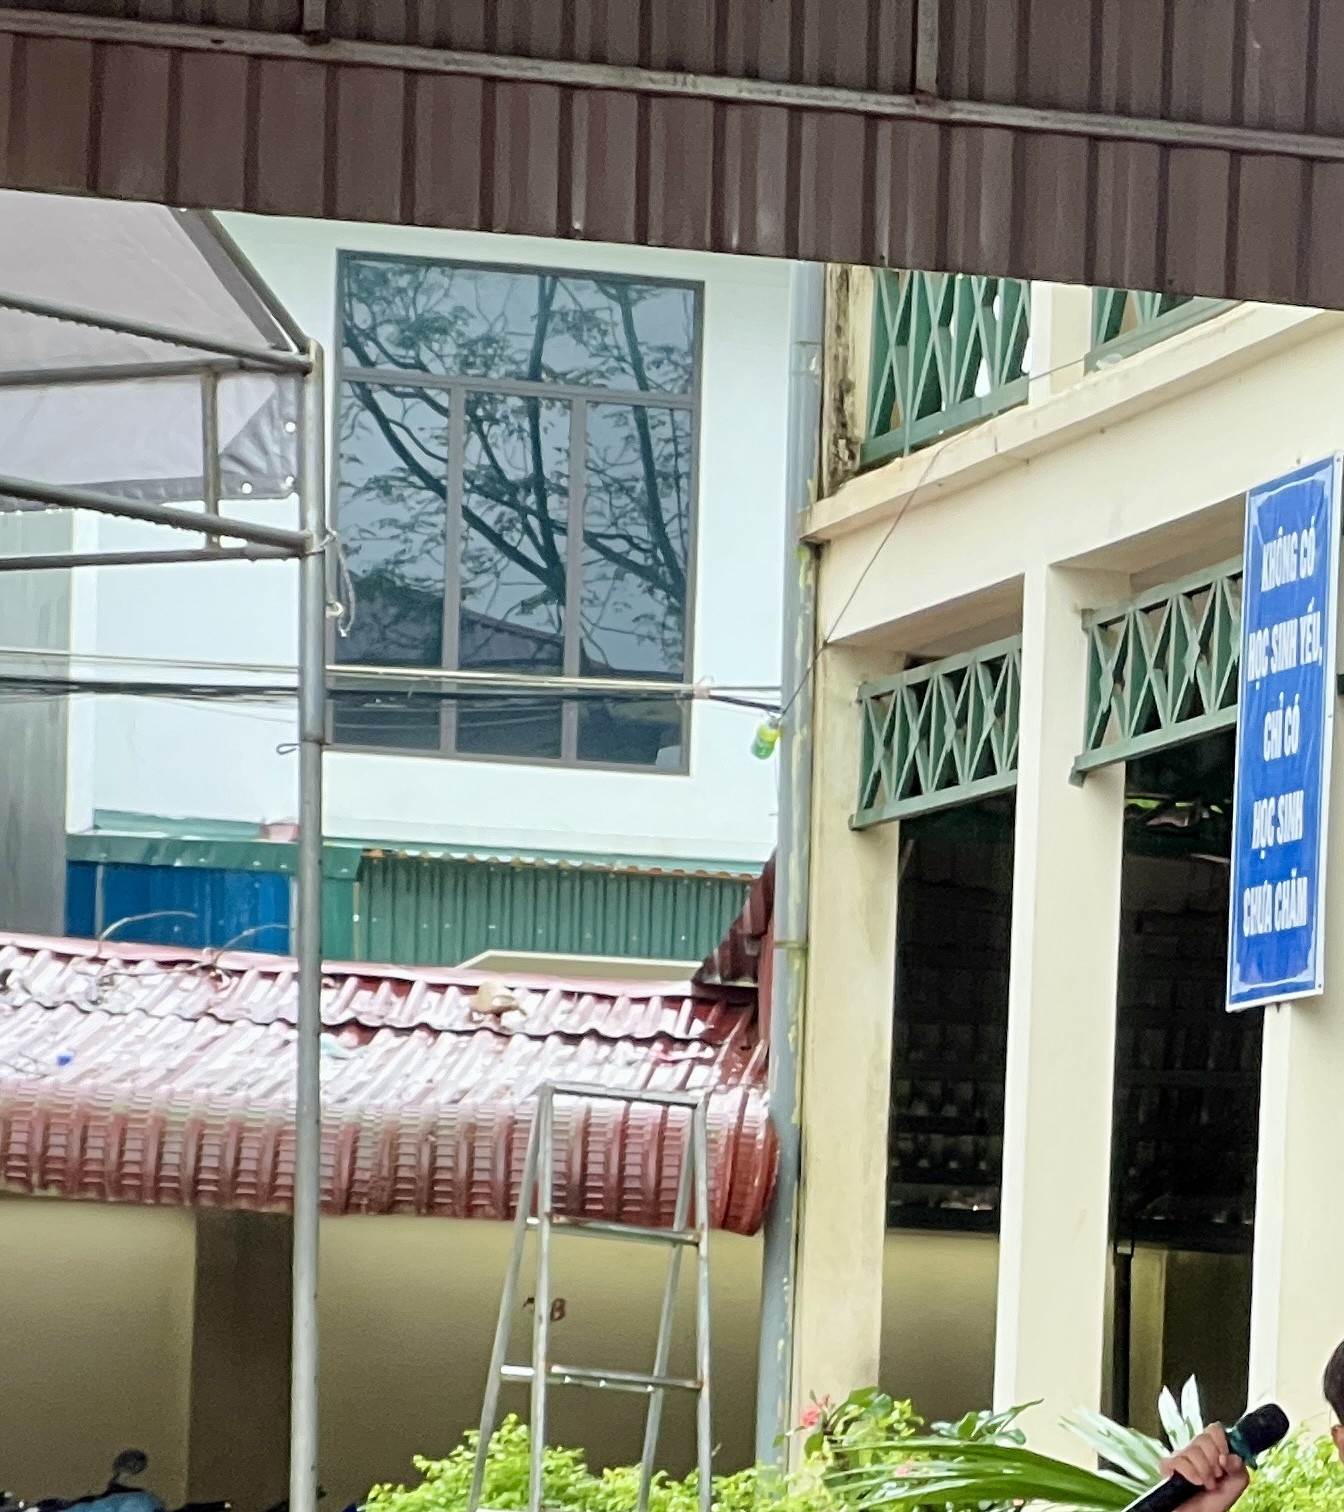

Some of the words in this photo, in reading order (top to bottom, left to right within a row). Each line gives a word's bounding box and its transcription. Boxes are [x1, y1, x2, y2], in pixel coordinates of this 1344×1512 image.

[1260, 526, 1299, 592] KHÔNG
[1299, 515, 1317, 579] CÓ
[1248, 627, 1270, 690] HỌC
[1270, 618, 1299, 674] SINH
[1263, 691, 1284, 761] CHỈ
[1284, 693, 1300, 756] CÓ
[1252, 796, 1276, 860] HỌC
[1276, 790, 1304, 844] SINH
